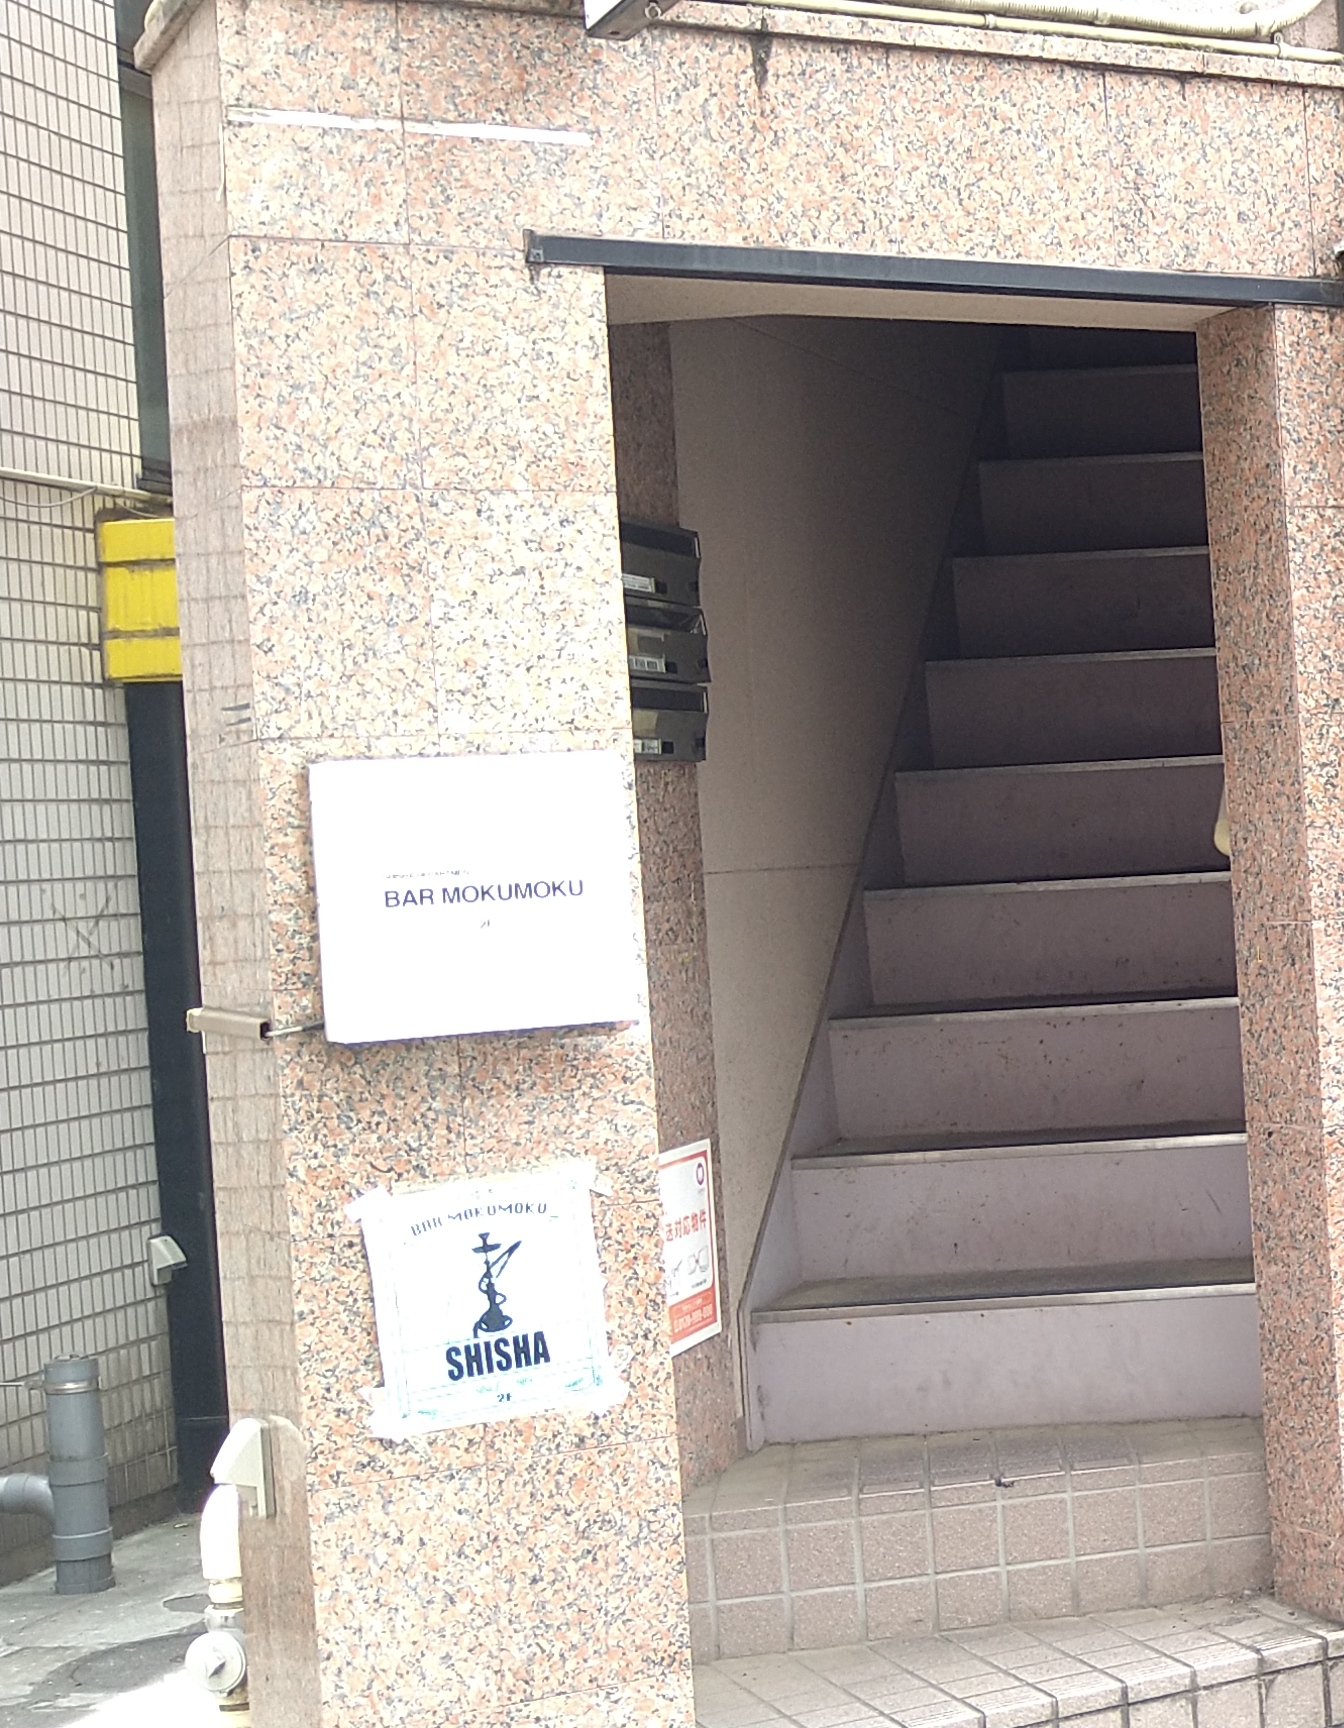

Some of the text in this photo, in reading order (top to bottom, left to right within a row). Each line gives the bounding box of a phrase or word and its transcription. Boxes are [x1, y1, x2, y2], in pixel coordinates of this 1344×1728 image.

[384, 879, 584, 908] BAR MOKUMOKU
[446, 1331, 550, 1381] SHISHA
